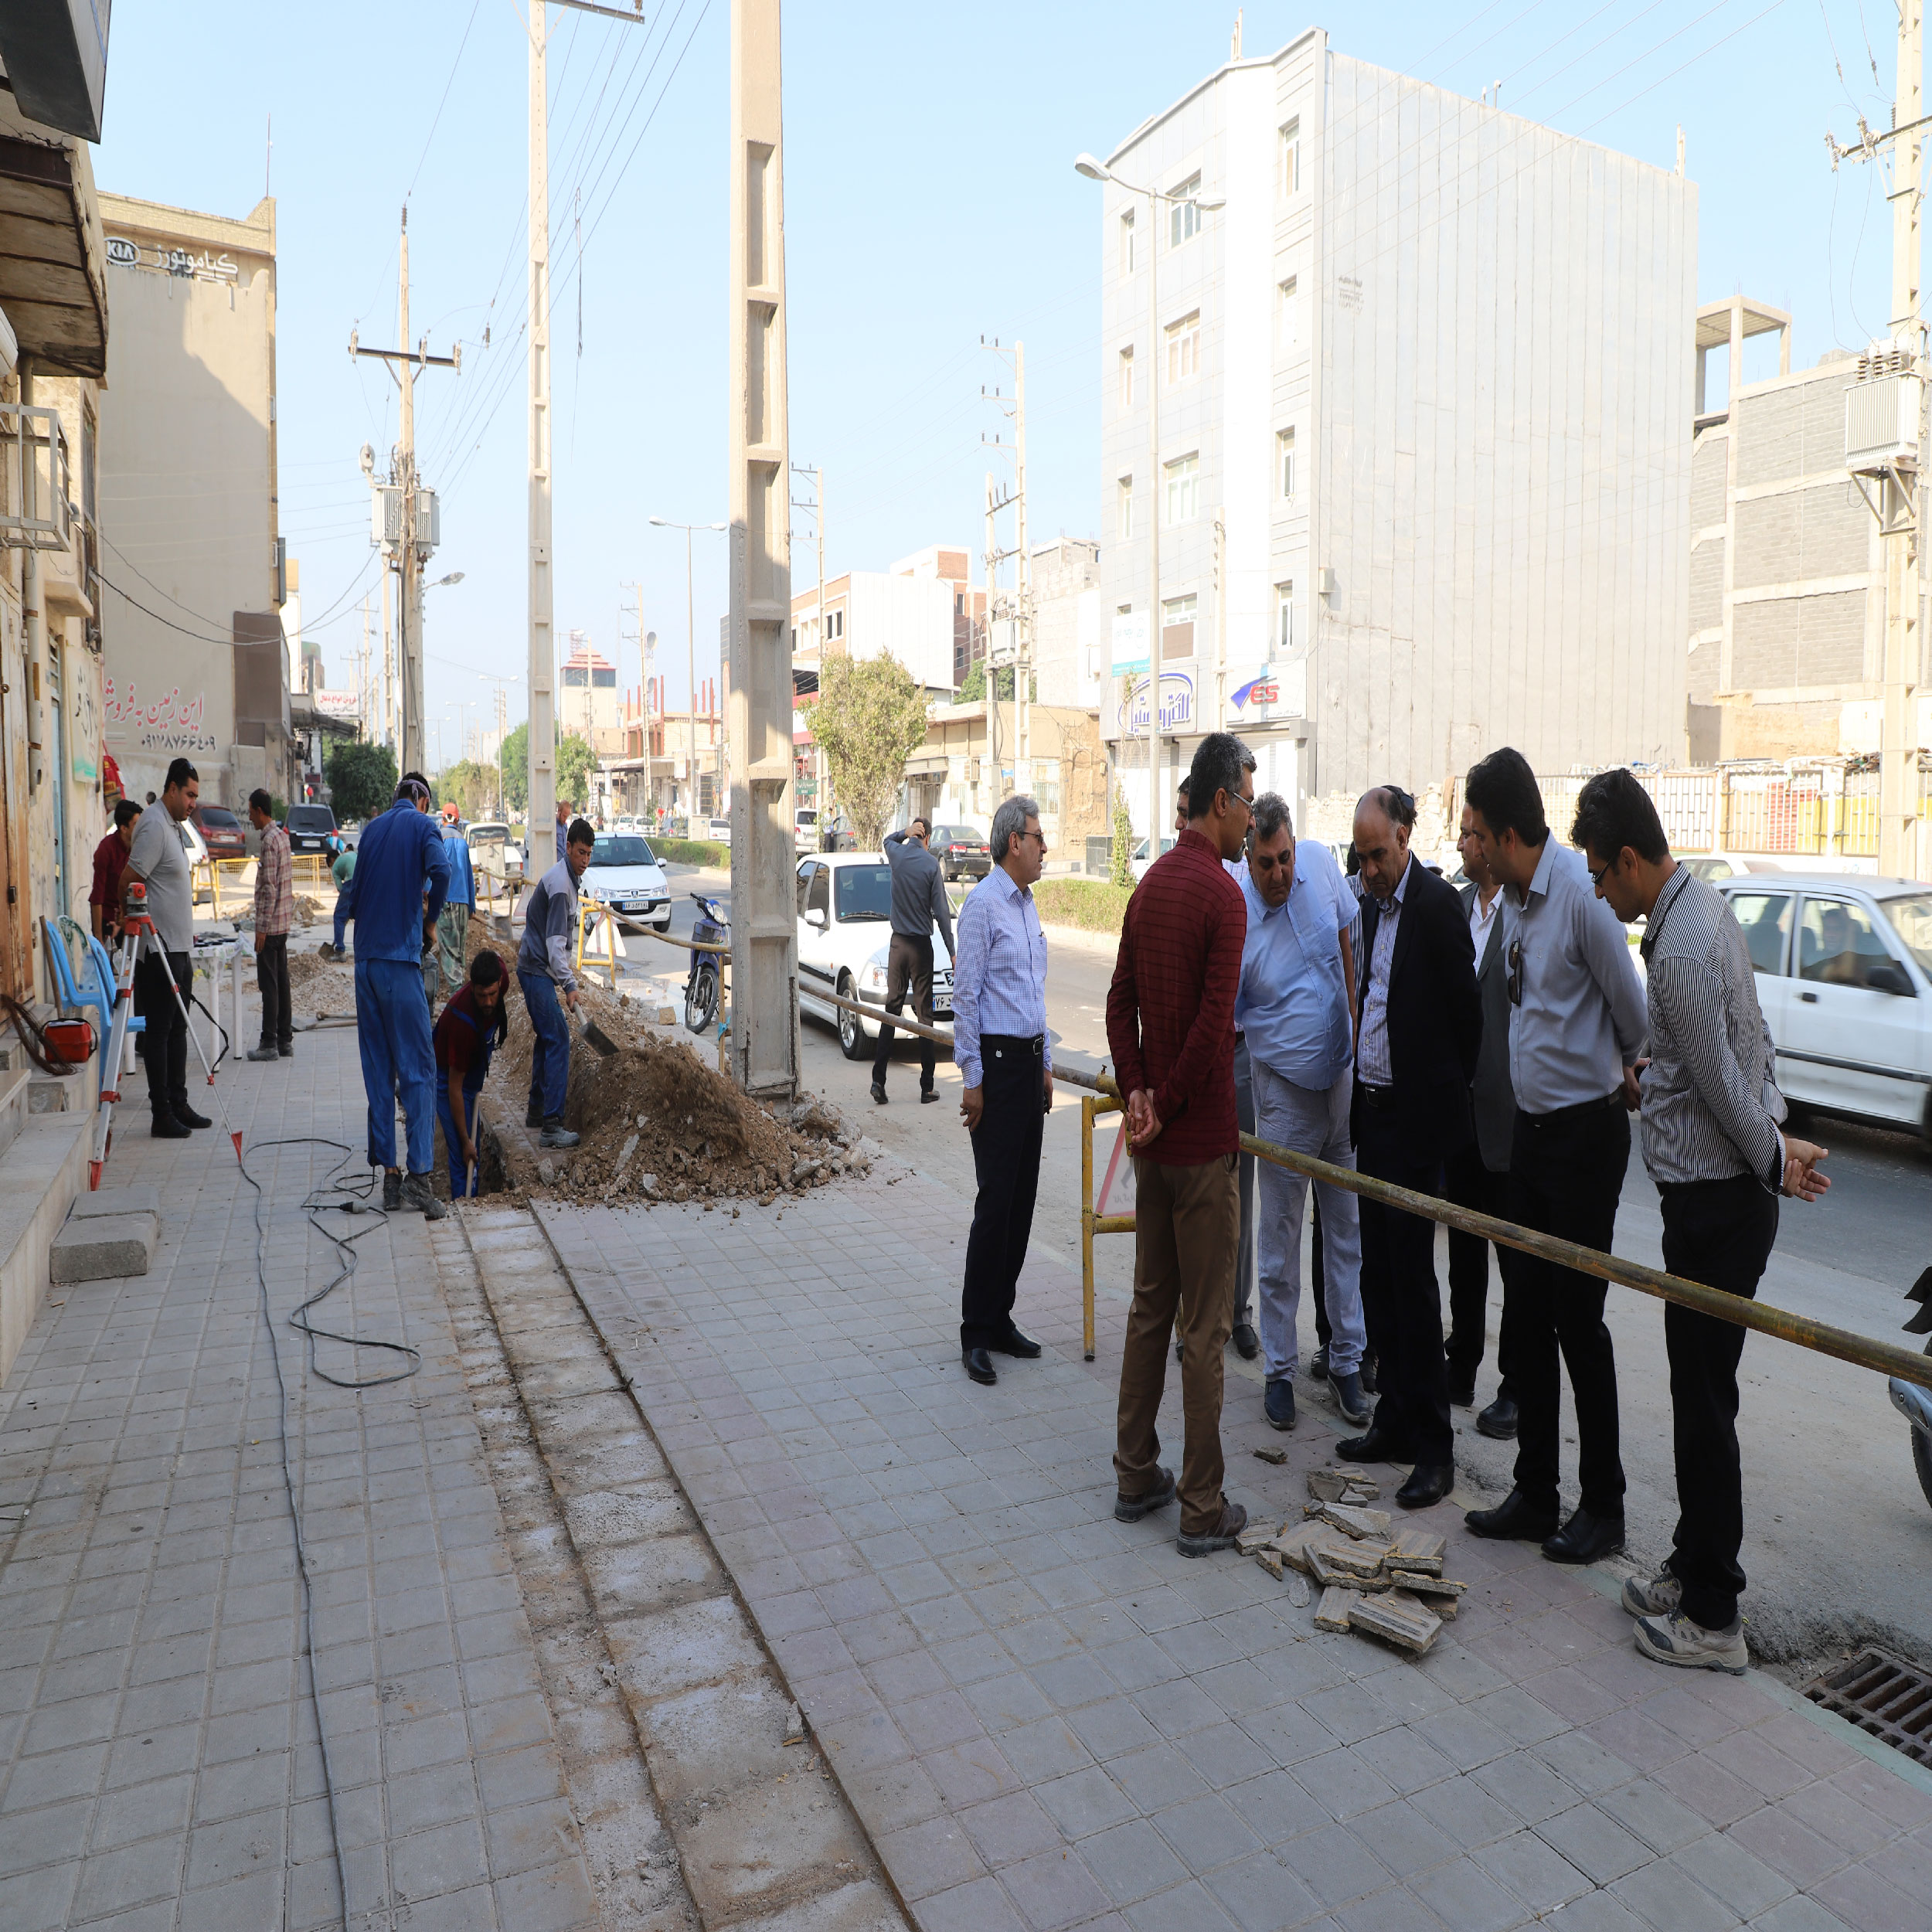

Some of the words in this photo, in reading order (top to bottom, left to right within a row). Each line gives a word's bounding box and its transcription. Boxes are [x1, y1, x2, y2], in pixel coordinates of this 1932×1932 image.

[106, 240, 134, 260] KIA
[1250, 685, 1279, 704] ES
[134, 706, 145, 728] به
[146, 687, 179, 730] زمین
[179, 695, 204, 731] این
